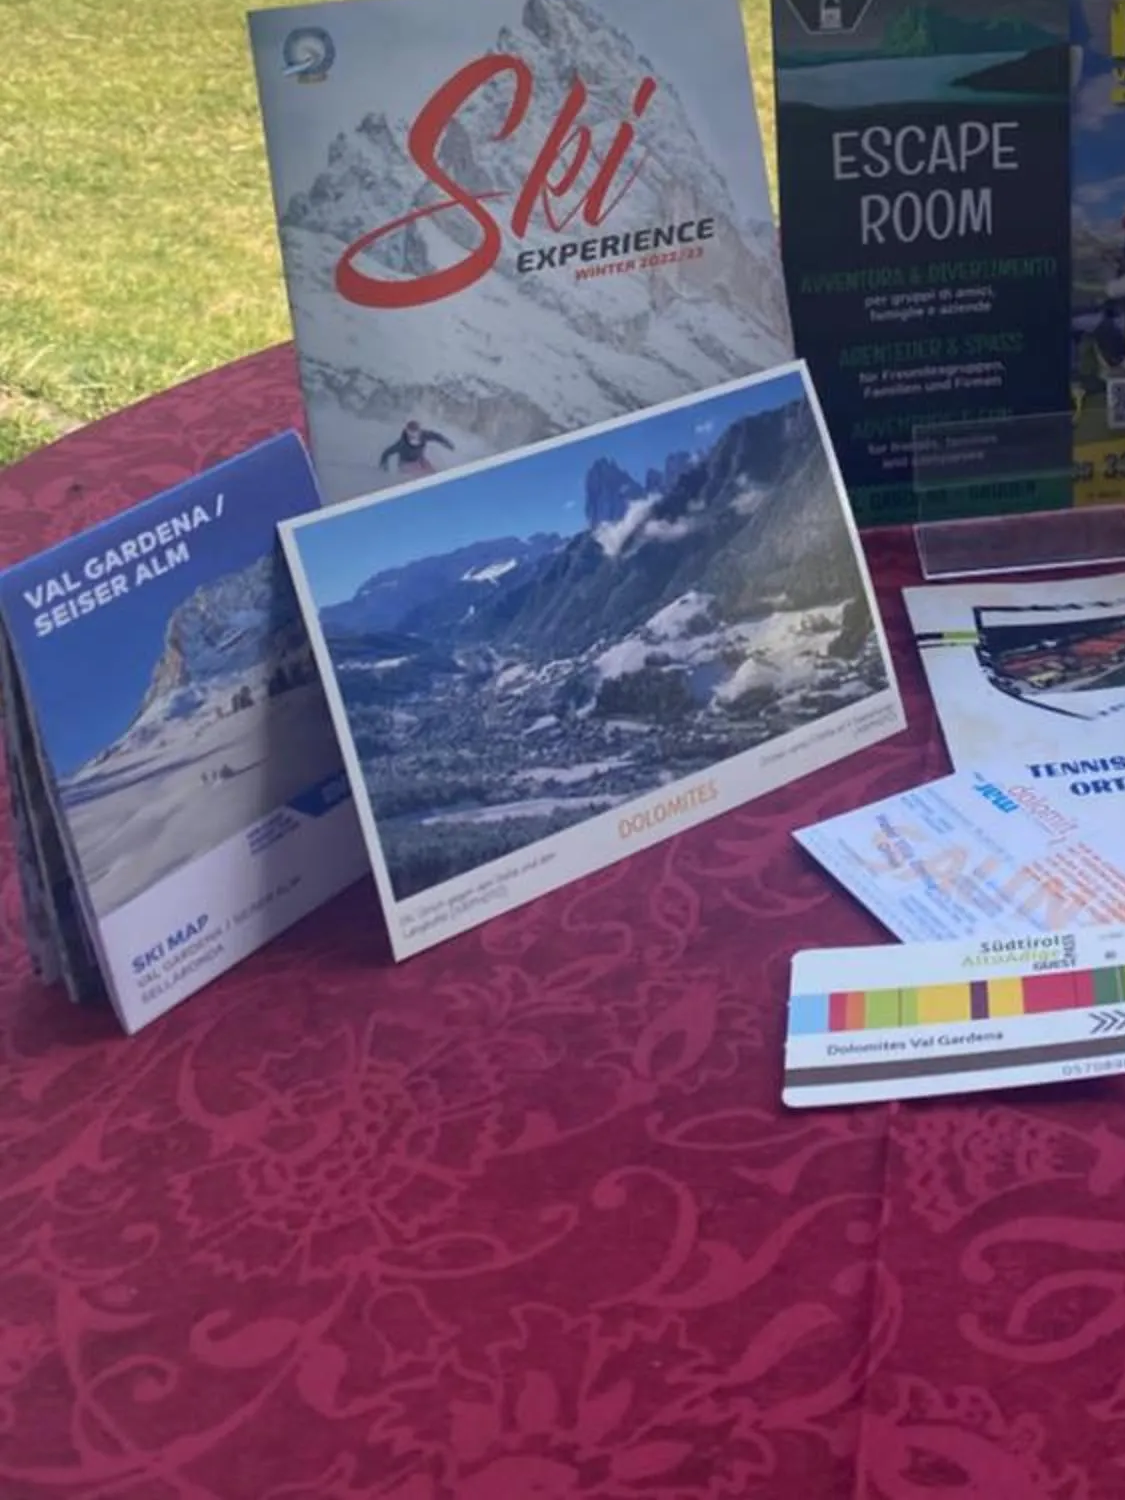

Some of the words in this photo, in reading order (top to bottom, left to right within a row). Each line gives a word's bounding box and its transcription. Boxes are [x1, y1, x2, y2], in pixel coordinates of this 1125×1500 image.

[335, 52, 657, 310] Ski
[831, 121, 1021, 181] ESCAPE
[516, 217, 715, 274] EXPERIENCE
[860, 186, 994, 245] ROOM
[575, 259, 636, 282] WINTER
[23, 571, 82, 610] VAL
[83, 504, 212, 581] GARDENA
[33, 573, 130, 638] SEISER
[135, 541, 191, 587] ALM
[617, 778, 720, 840] DOLOMITES
[131, 941, 166, 974] SKI
[166, 913, 210, 951] MAP
[980, 934, 1060, 954] Südtirol
[826, 1038, 907, 1057] Dolomites
[910, 1034, 935, 1050] Val
[937, 1030, 1004, 1047] Gardena
